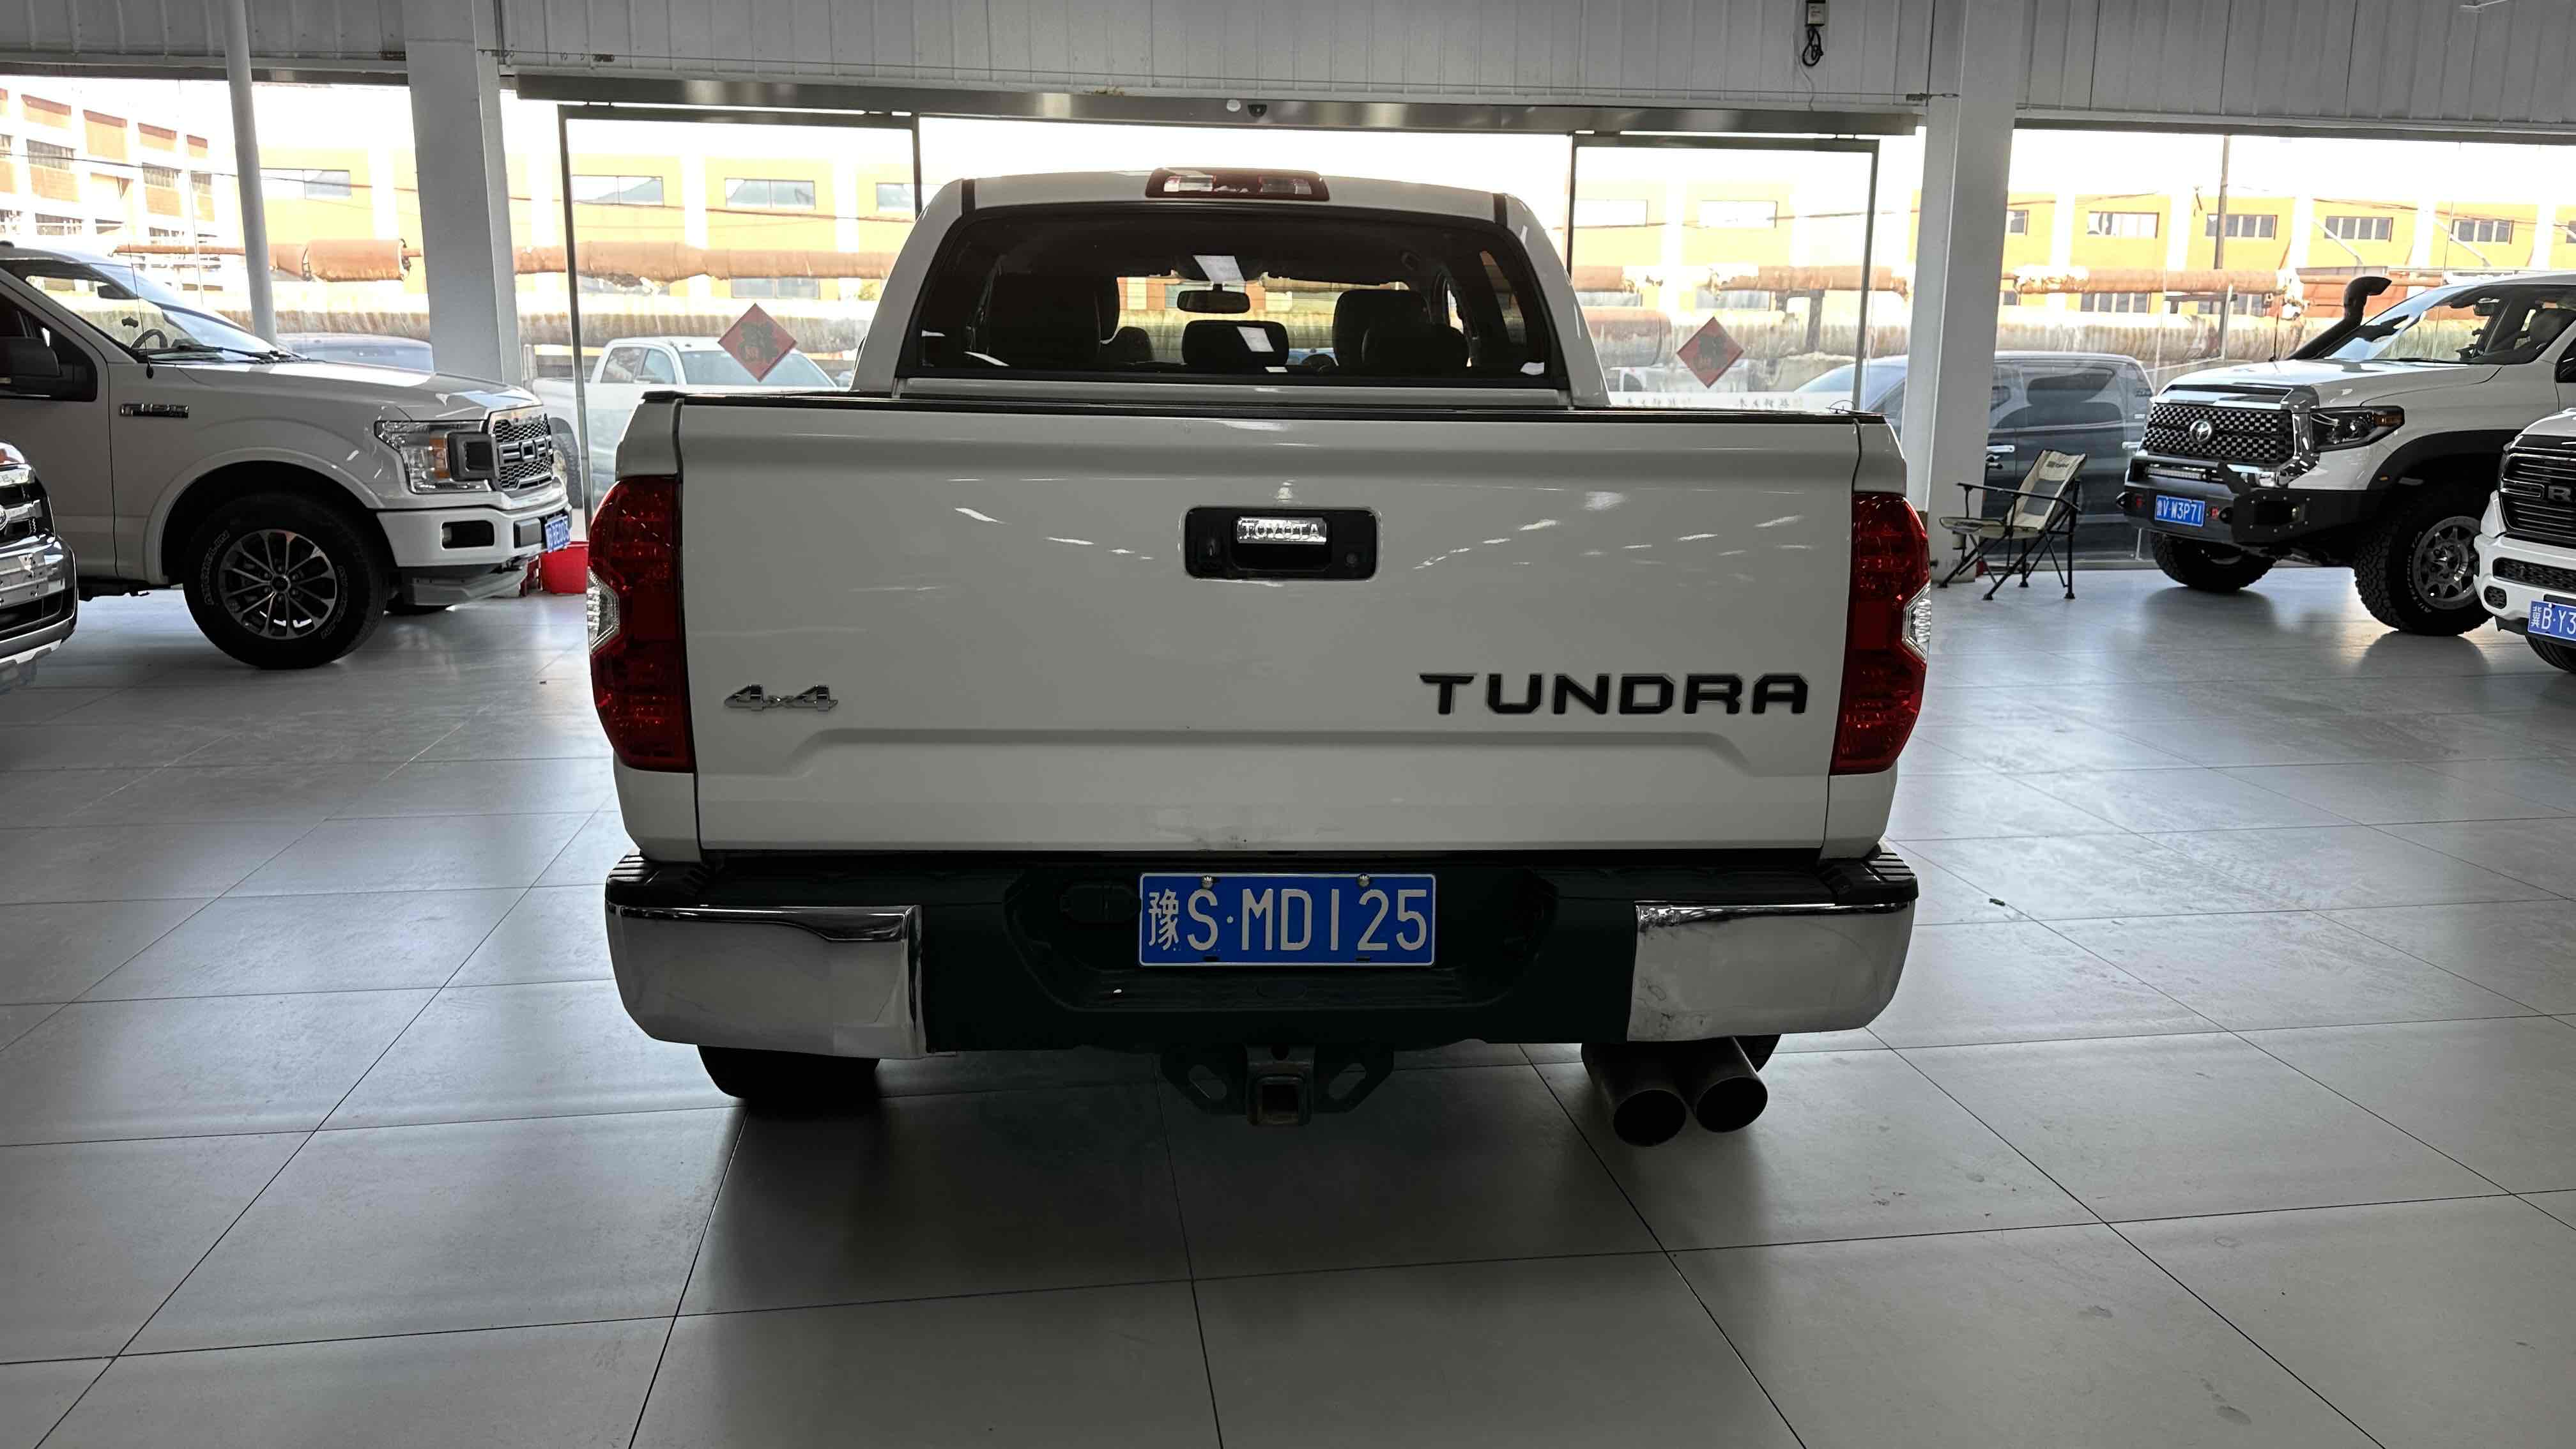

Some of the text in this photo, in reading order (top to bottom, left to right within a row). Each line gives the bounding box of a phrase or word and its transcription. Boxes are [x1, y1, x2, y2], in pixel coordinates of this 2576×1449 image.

[1241, 521, 1320, 540] TOYOTA
[724, 684, 839, 712] 4x4
[1419, 673, 1809, 715] TUNDRA
[1148, 888, 1428, 951] 豫S·MD125
